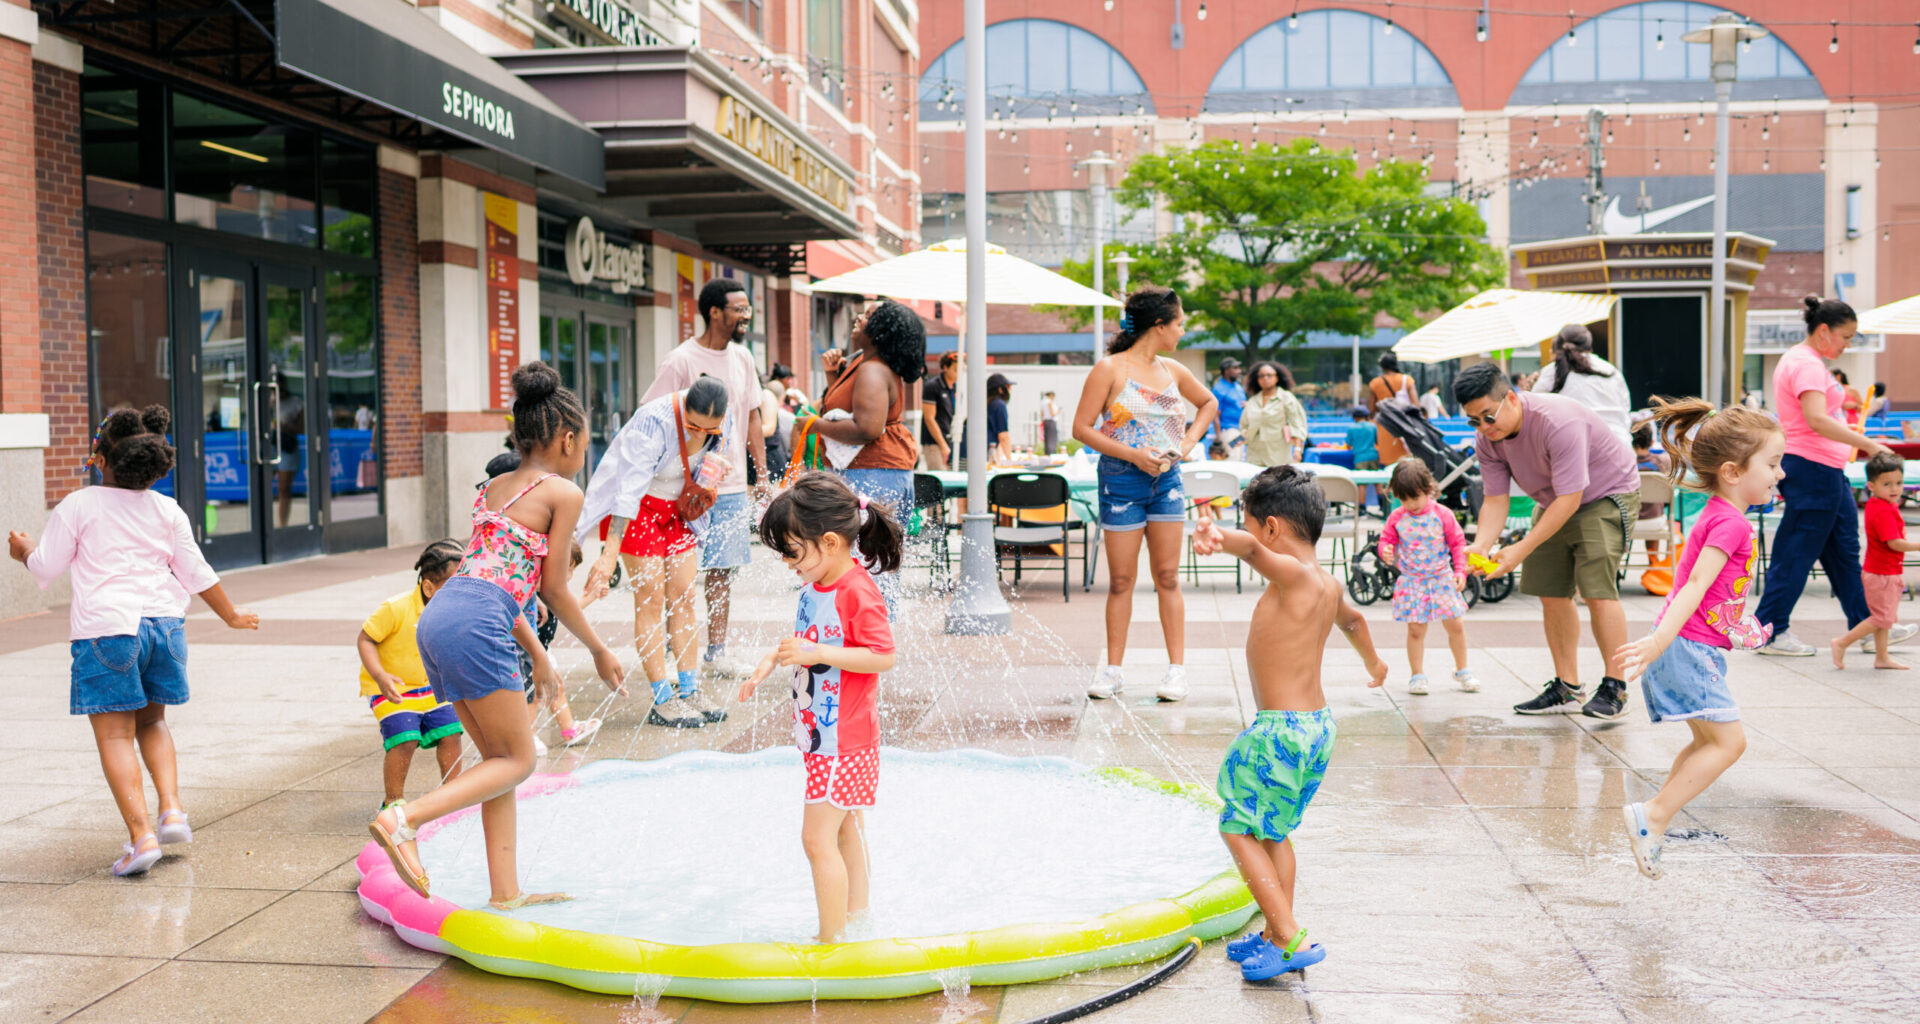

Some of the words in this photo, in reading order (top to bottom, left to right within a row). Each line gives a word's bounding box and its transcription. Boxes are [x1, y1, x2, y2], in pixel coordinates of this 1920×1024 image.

[442, 81, 515, 140] SEPHORA
[715, 95, 796, 180] ATLANTIC
[597, 231, 645, 294] target
[1534, 246, 1597, 264] ATLANTIC
[1619, 243, 1713, 257] ATLANTIC
[1619, 267, 1712, 280] TERMINAL
